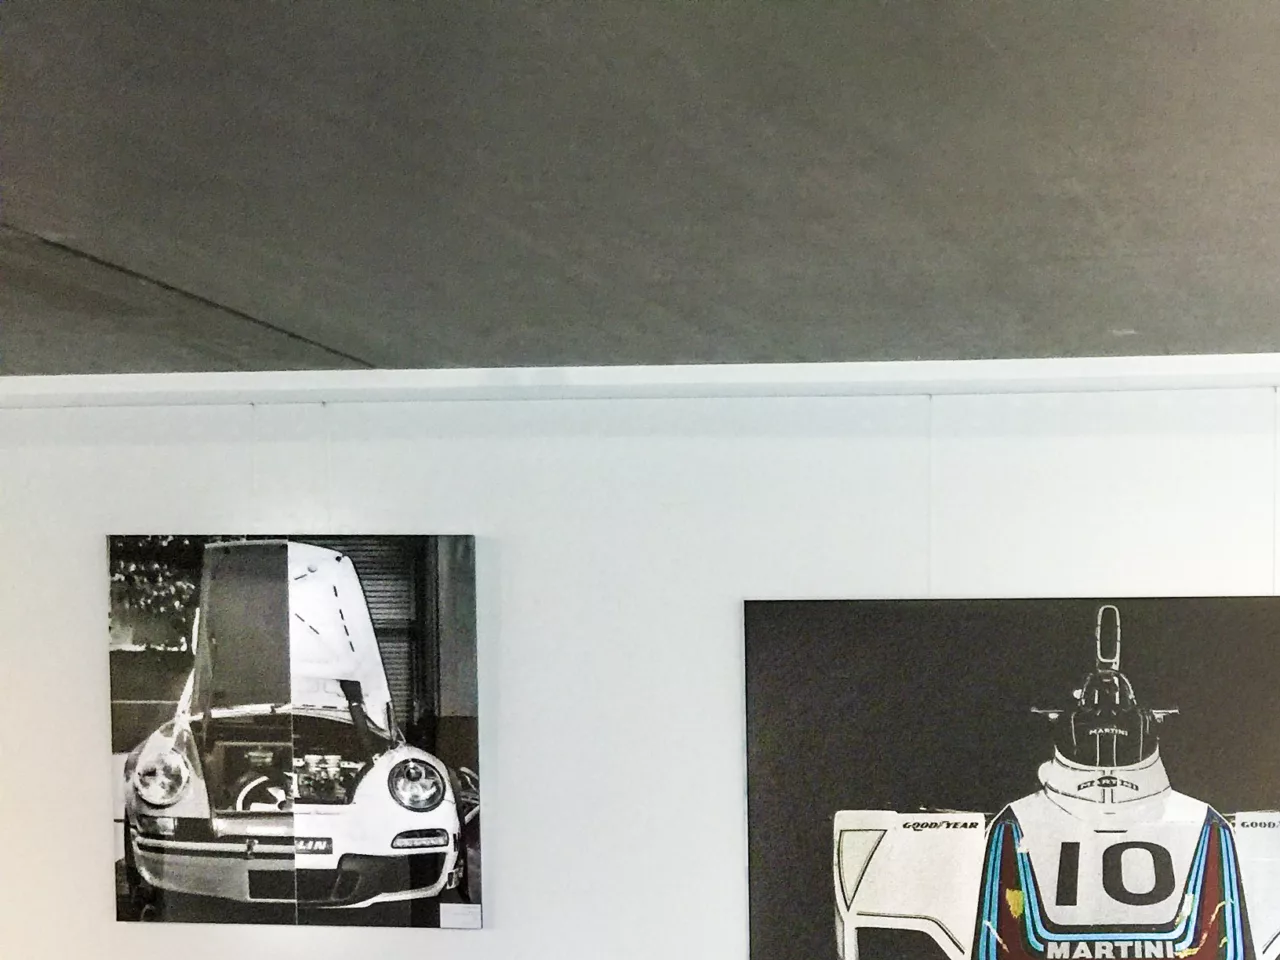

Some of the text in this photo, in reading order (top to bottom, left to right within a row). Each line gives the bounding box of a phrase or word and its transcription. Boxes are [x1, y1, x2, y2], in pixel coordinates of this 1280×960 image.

[1089, 727, 1128, 736] MARTINI
[1055, 841, 1176, 906] 10
[1047, 941, 1175, 959] MARTINI
